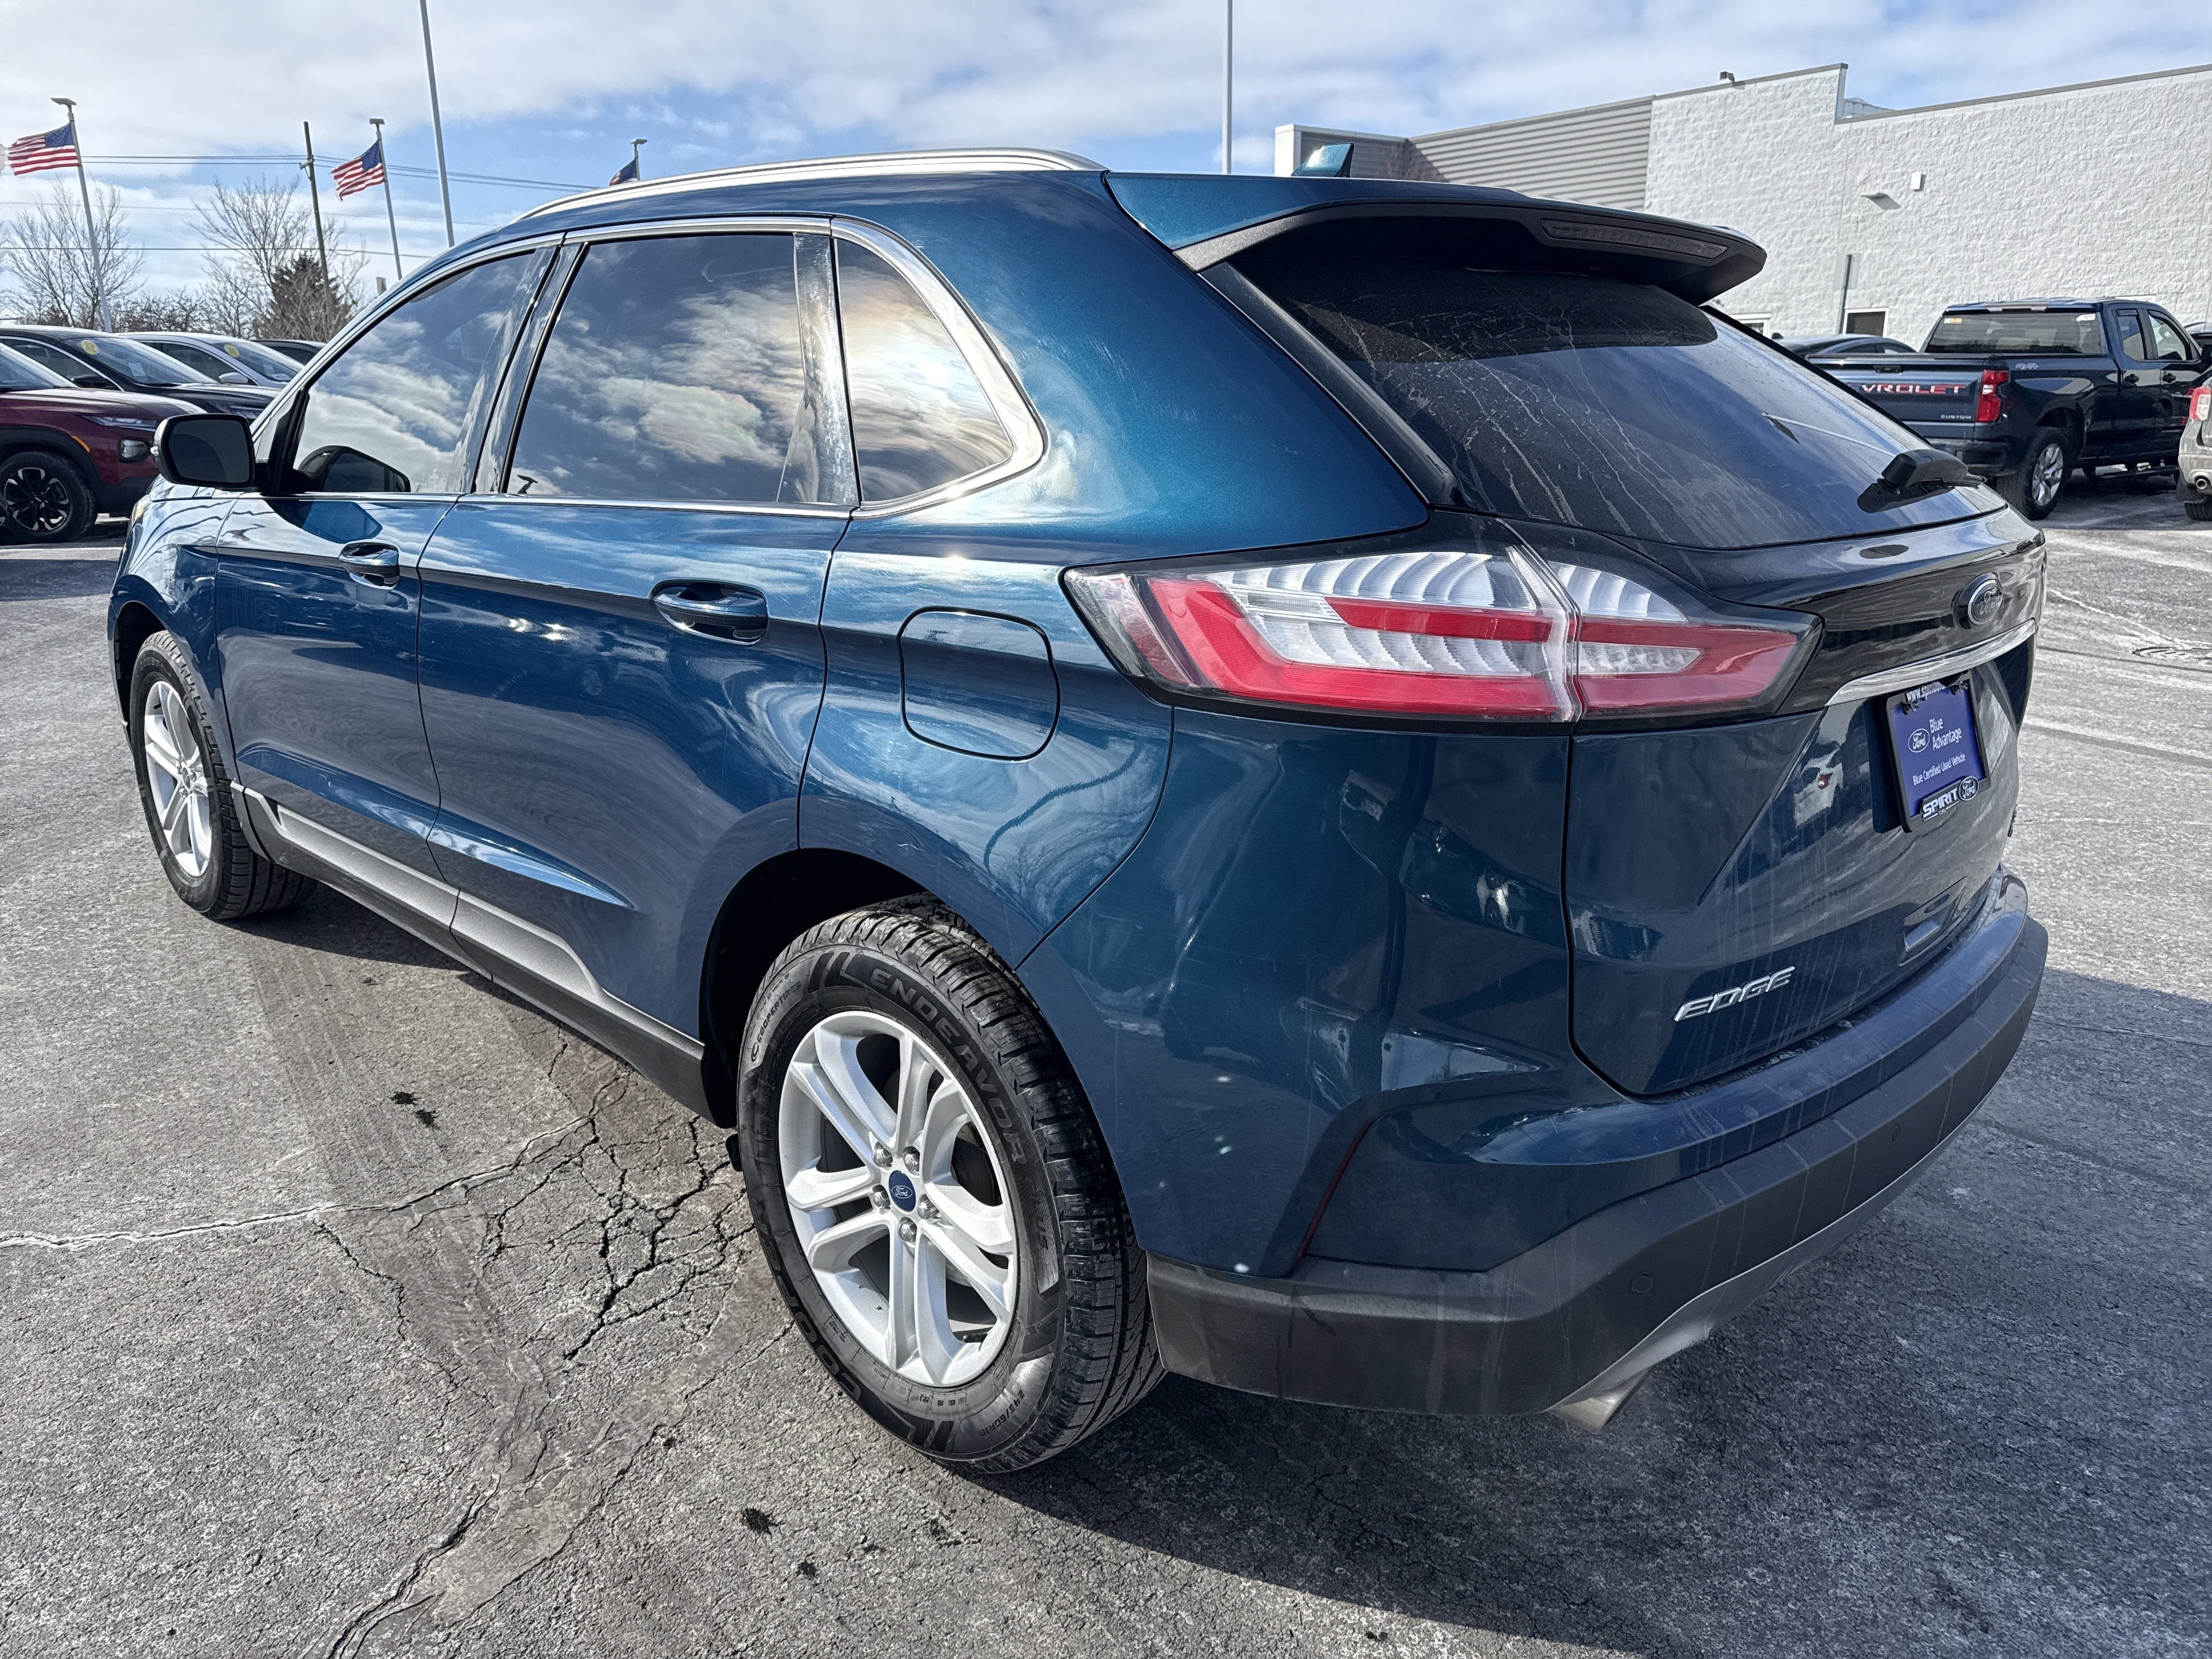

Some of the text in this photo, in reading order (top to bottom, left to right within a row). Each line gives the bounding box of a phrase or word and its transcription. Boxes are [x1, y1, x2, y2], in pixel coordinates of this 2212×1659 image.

[1929, 717, 1943, 733] Blue
[1932, 727, 1962, 751] Advantage
[1912, 752, 1966, 786] Blue Certified Used Vehicle
[1922, 787, 1957, 818] SPIRIT
[1673, 966, 1796, 1022] EDGE
[870, 968, 1027, 1164] ENDEAVOR
